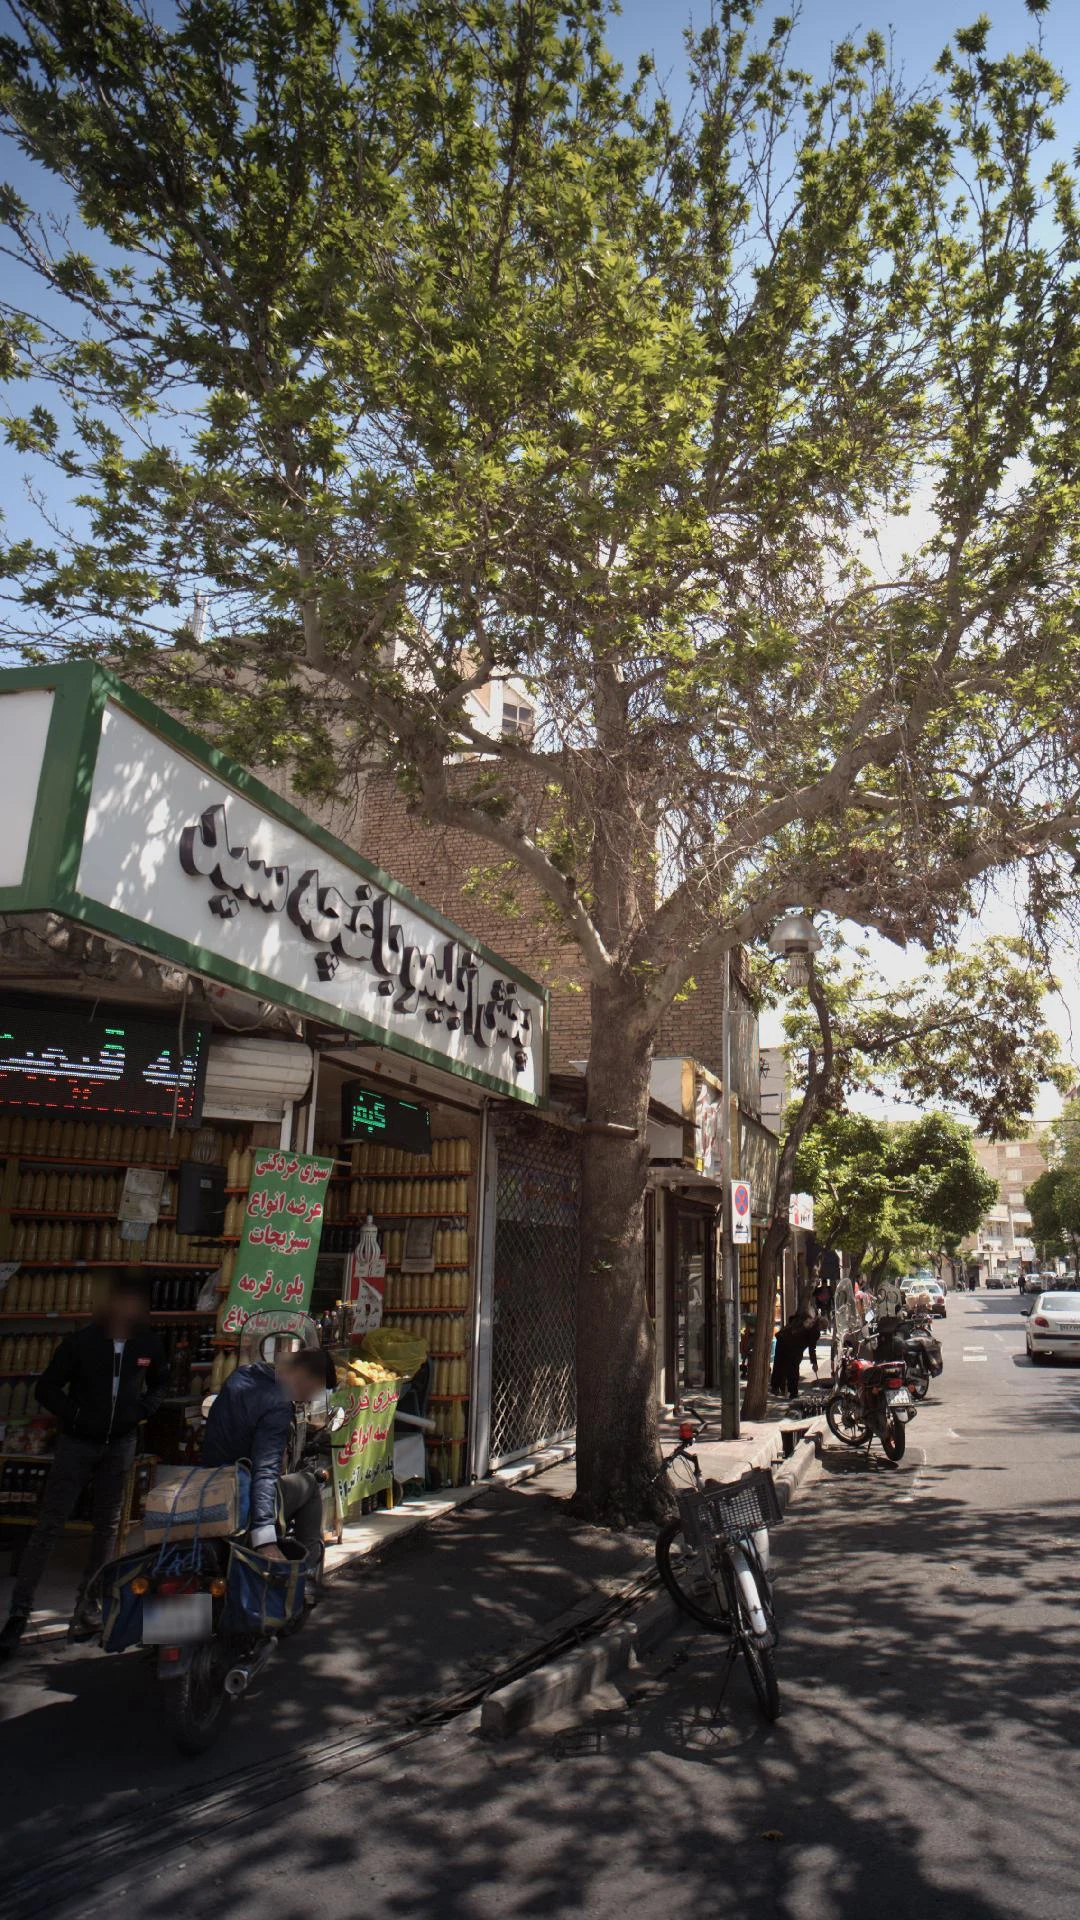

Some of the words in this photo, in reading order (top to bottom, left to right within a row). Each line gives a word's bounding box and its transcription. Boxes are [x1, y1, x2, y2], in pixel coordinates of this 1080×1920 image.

[394, 941, 484, 1036] آبلیمو
[473, 979, 532, 1073] پخش
[299, 1162, 330, 1185] سبزی
[247, 1189, 286, 1219] انواع
[286, 1195, 323, 1223] عرضه
[248, 1223, 311, 1255] سبزیجات
[238, 1270, 273, 1300] قرمه
